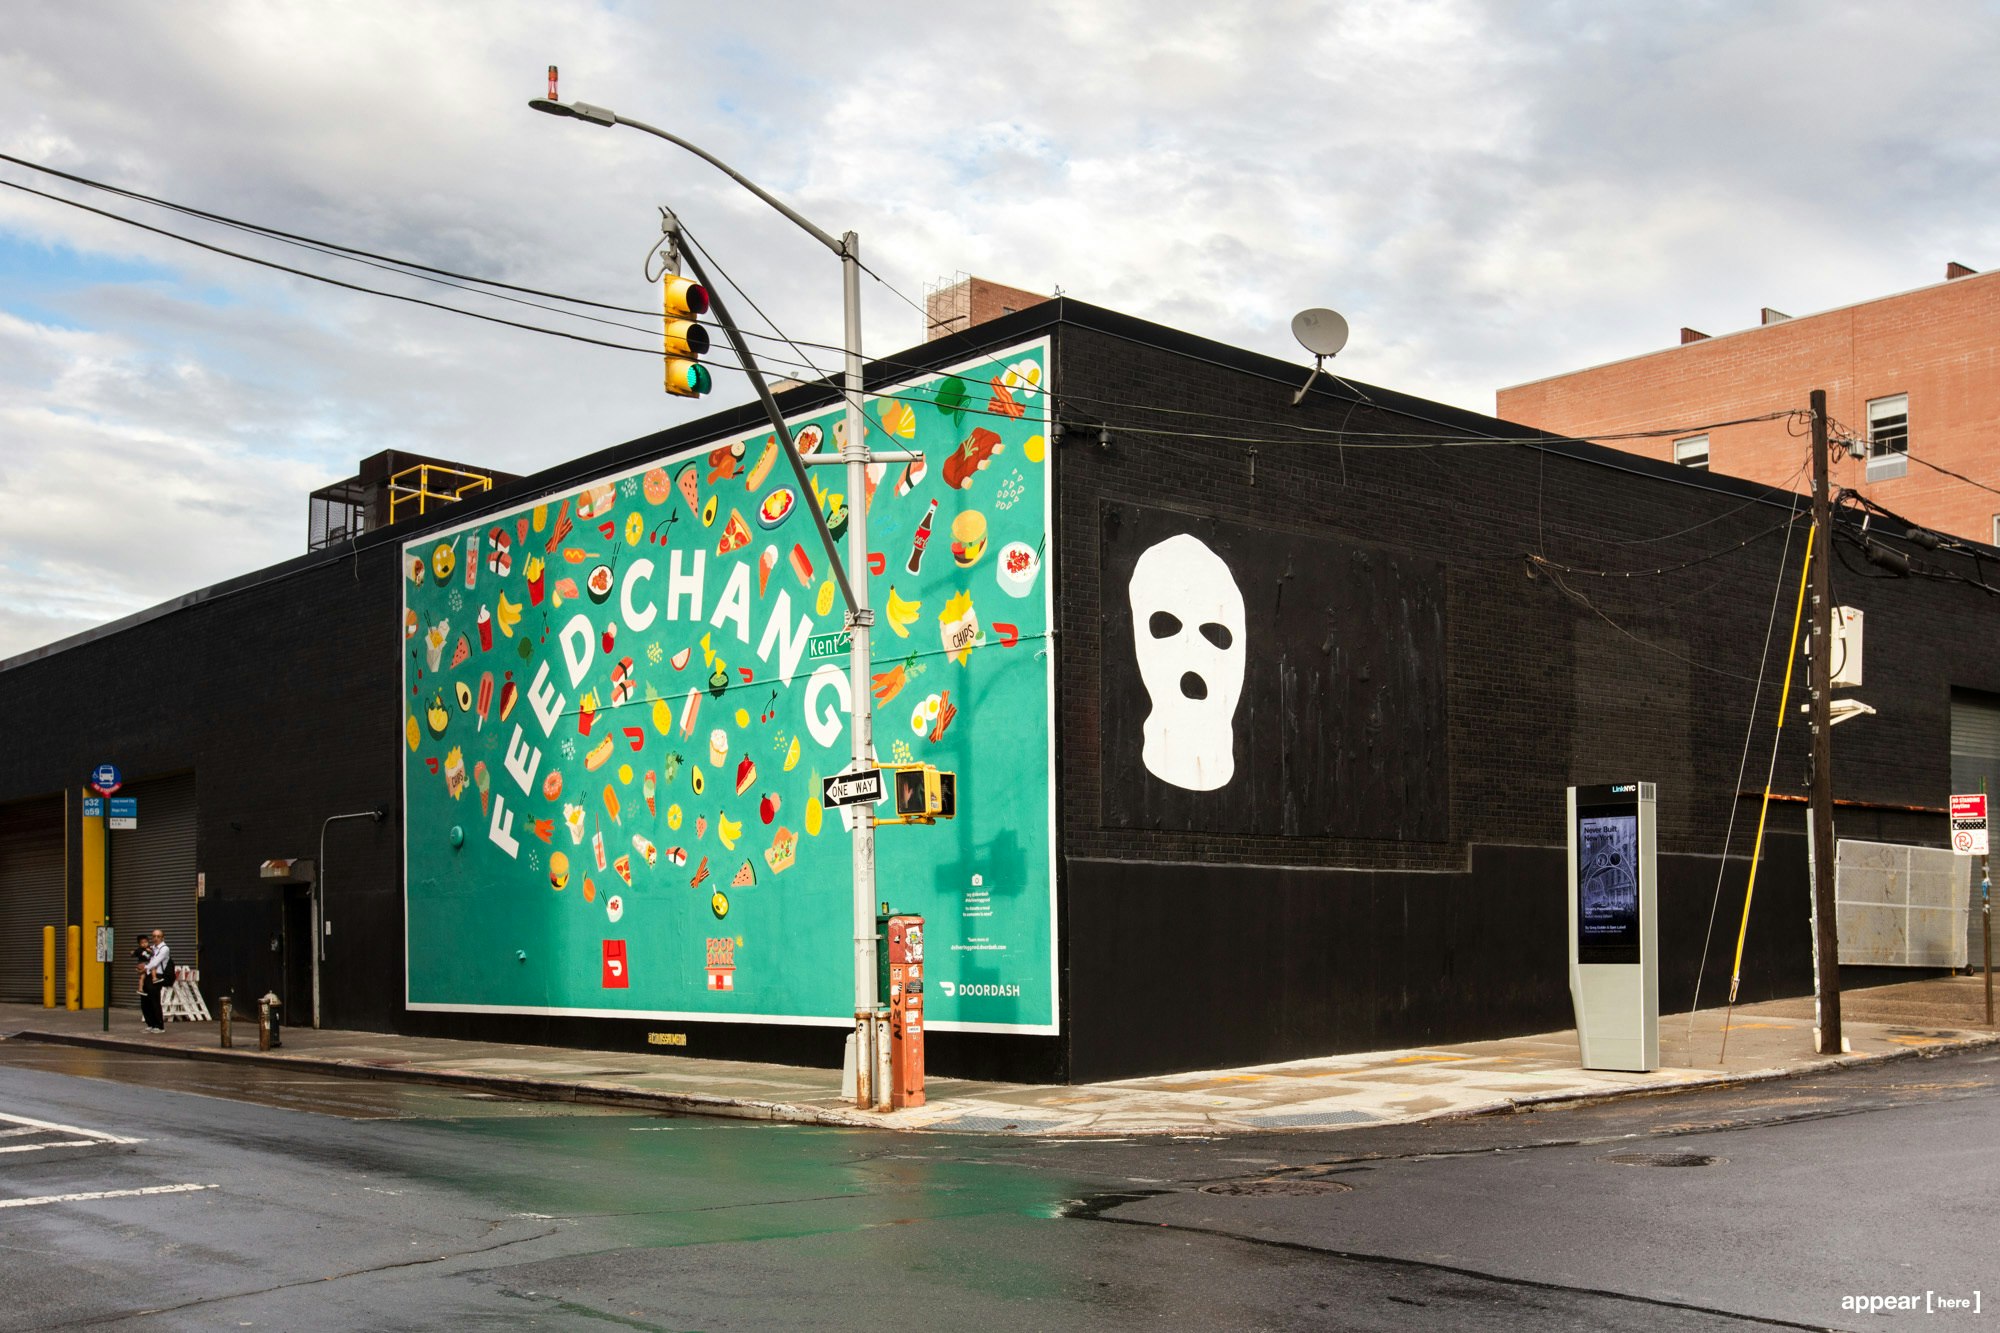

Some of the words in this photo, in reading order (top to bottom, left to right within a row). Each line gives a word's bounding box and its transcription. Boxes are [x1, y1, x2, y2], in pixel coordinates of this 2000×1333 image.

[953, 623, 975, 648] CHIPS
[810, 635, 839, 657] Kent
[488, 613, 596, 860] FEED
[832, 784, 848, 798] ONE
[855, 780, 873, 793] WAY
[1612, 784, 1636, 793] LinkNYC
[706, 938, 734, 952] FOOD
[706, 952, 734, 967] BANK
[960, 984, 1020, 996] DOORDASH
